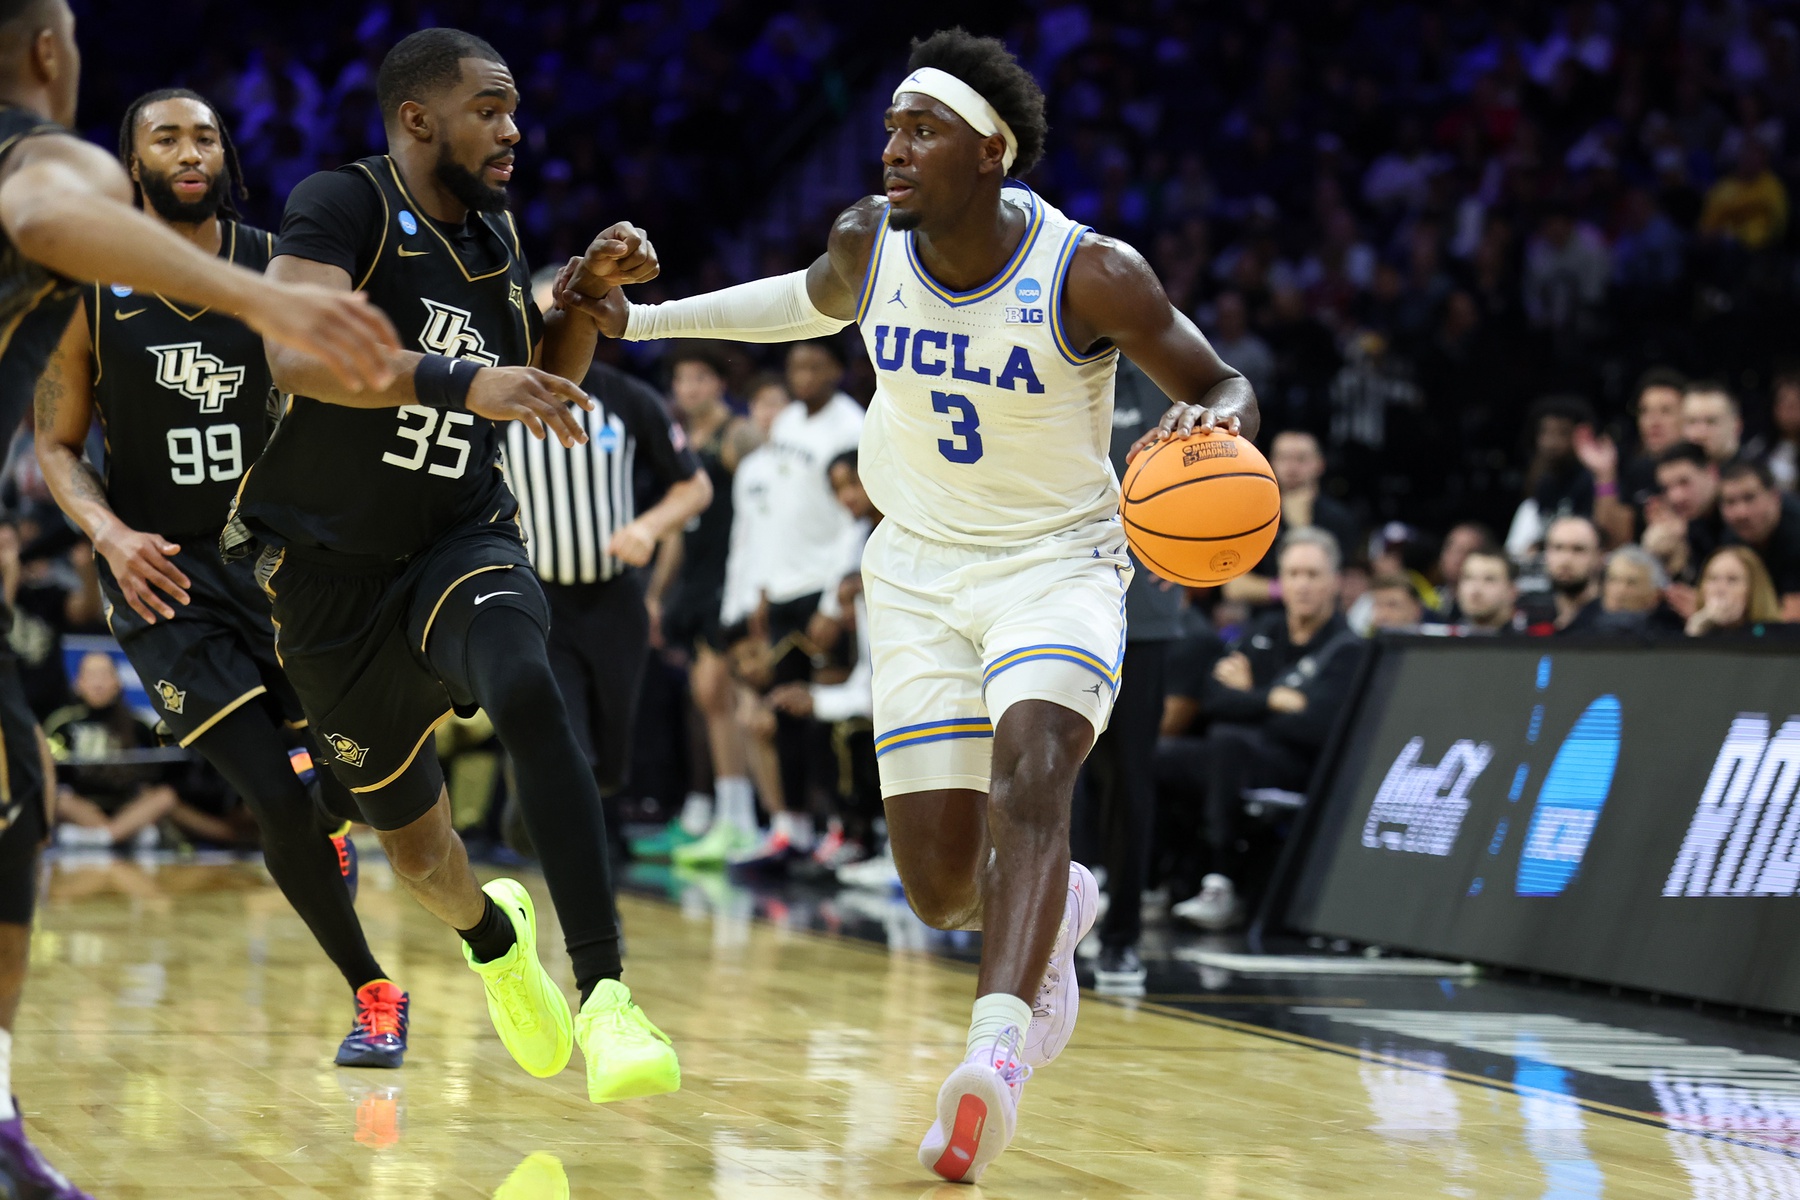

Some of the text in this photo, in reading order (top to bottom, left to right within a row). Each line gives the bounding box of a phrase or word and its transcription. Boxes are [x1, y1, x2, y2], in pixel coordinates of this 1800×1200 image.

[1018, 289, 1040, 297] NCAA
[145, 341, 245, 413] UCF
[874, 325, 1046, 394] UCLA
[166, 423, 244, 485] 99
[381, 404, 474, 480] 35
[930, 390, 984, 465] 3
[1192, 441, 1222, 451] MARCH
[1198, 447, 1238, 458] MADNESS
